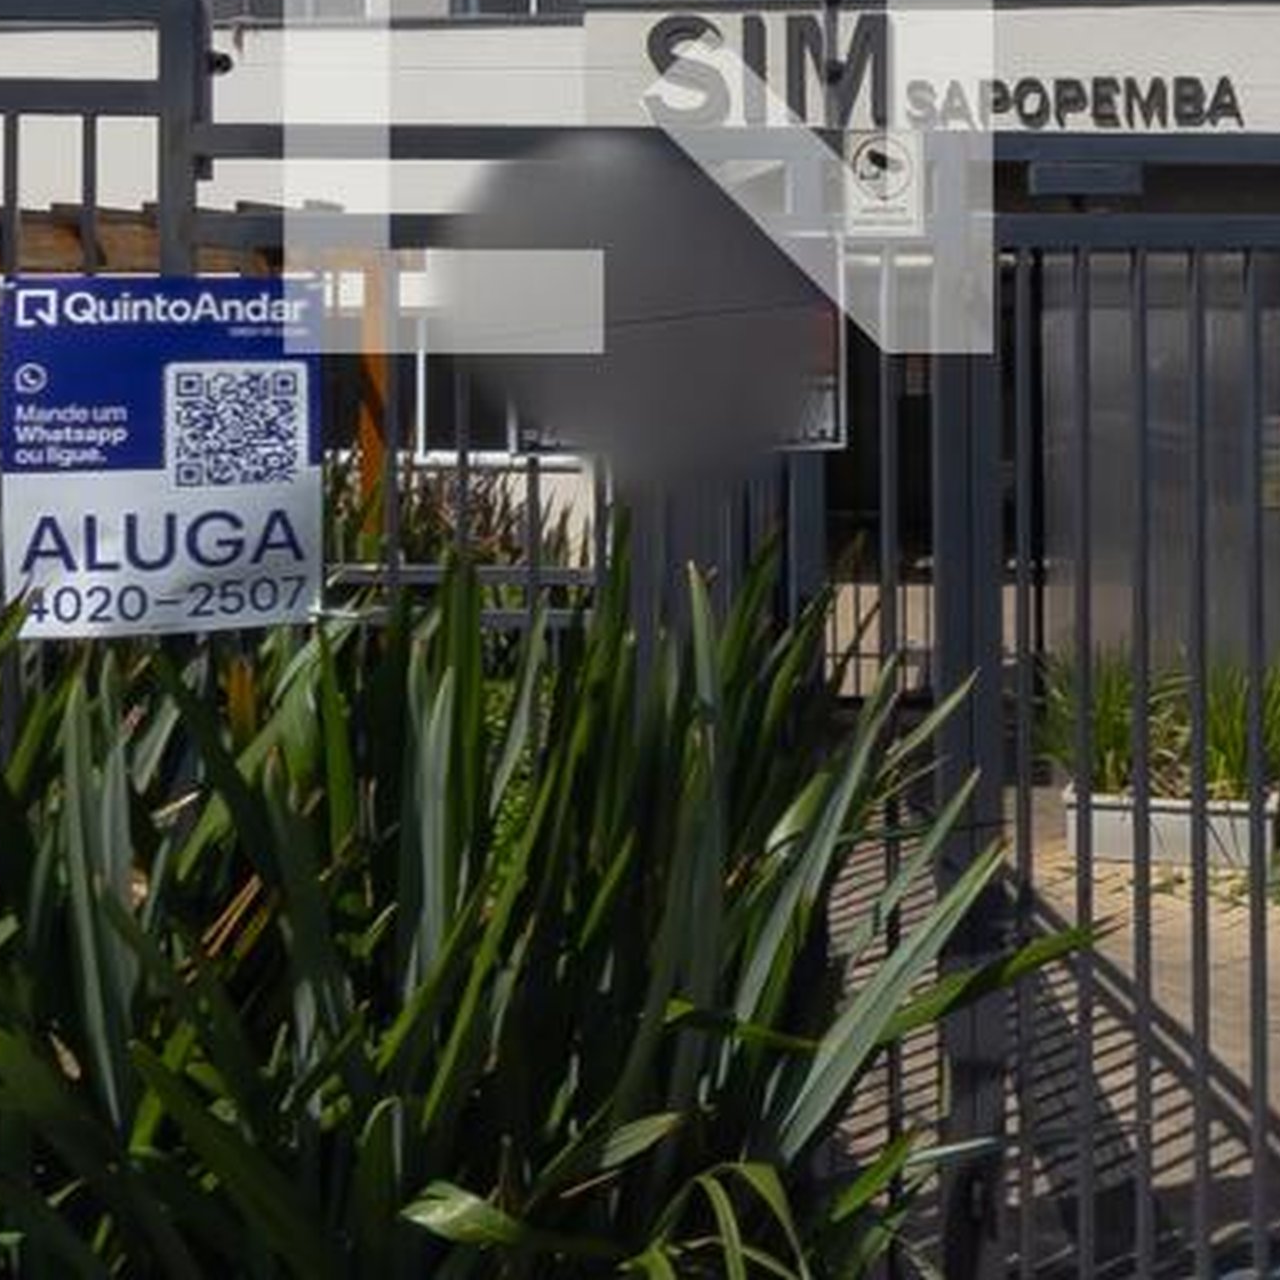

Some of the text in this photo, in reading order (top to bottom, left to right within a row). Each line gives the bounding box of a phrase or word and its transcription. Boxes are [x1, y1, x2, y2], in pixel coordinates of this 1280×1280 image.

[643, 14, 1244, 128] SIM SAPOPEMBA
[63, 291, 308, 324] QuintoAndar
[15, 405, 128, 423] Mande um
[14, 425, 129, 446] Whatsapp
[15, 446, 108, 467] ou ligue.
[22, 509, 305, 572] ALUGA
